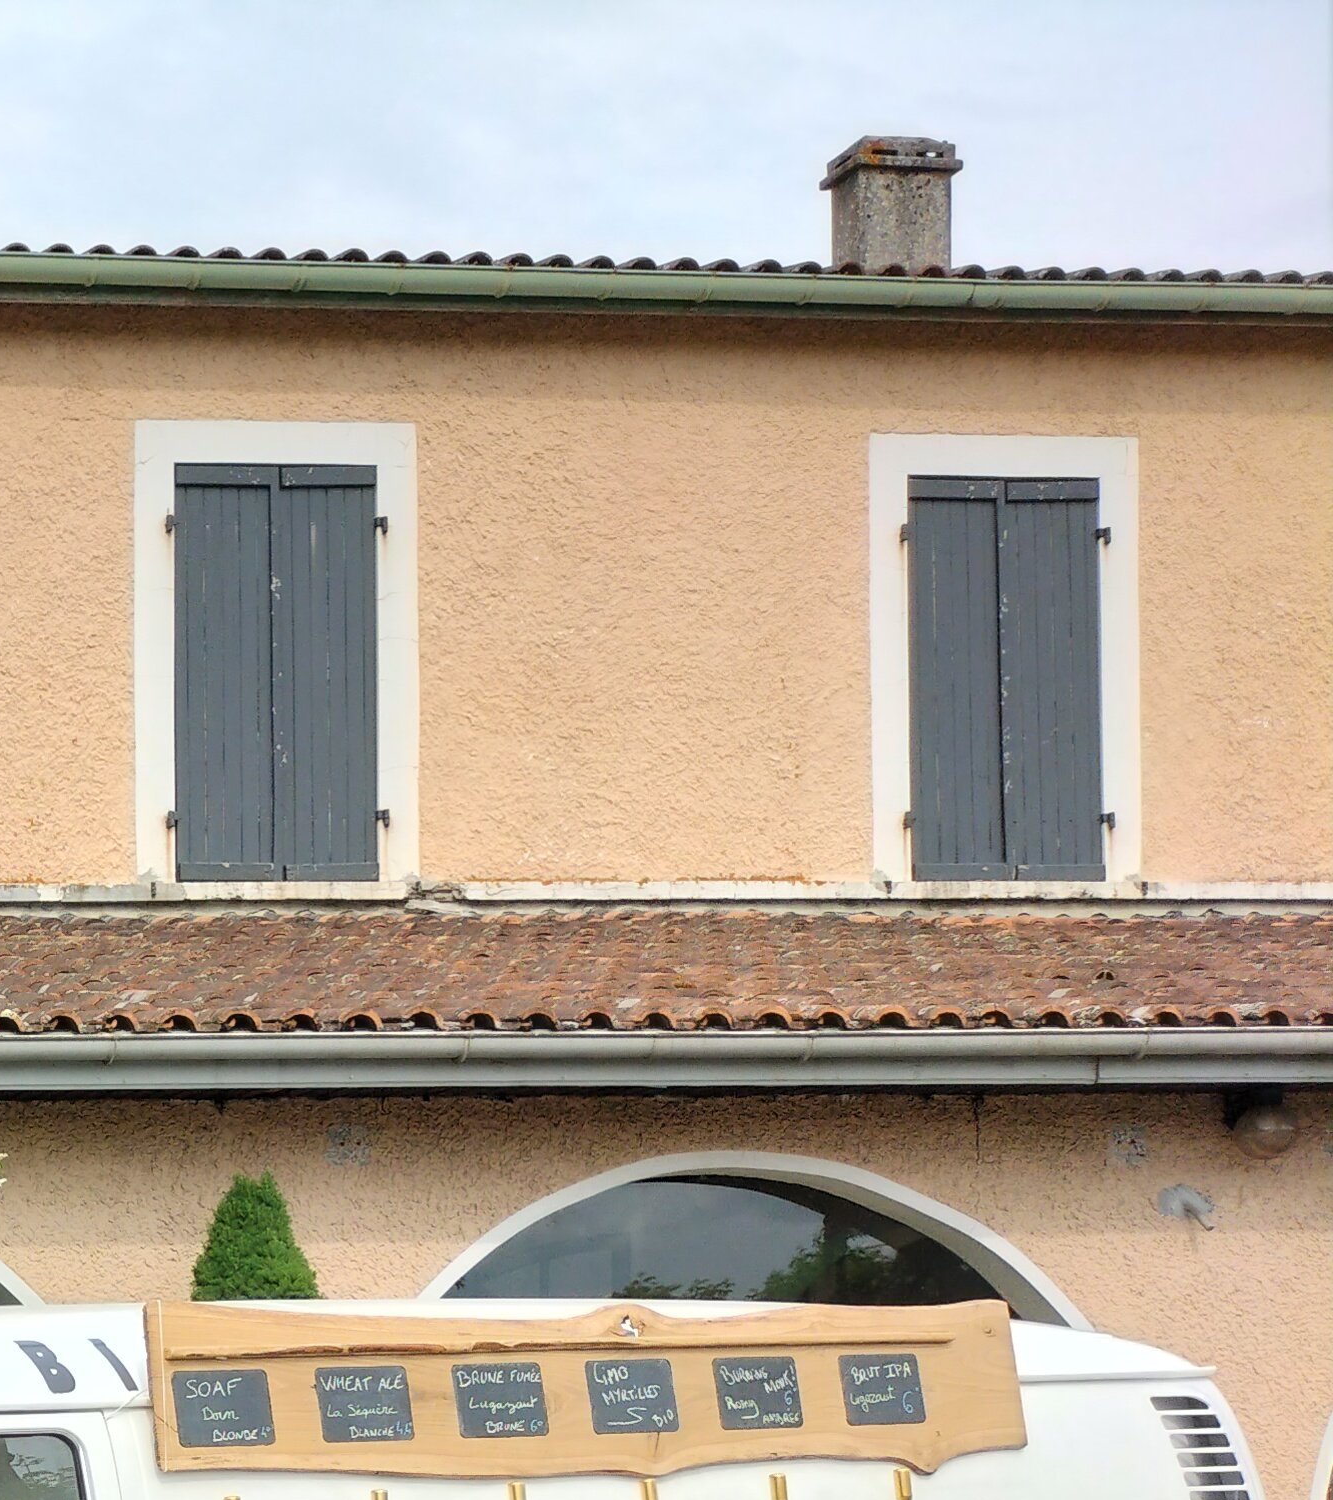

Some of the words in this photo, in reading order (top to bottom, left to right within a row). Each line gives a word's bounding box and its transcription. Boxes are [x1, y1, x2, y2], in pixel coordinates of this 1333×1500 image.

[457, 1370, 504, 1387] BRUNE
[851, 1366, 880, 1385] BRUT
[883, 1362, 912, 1378] IPA
[185, 1377, 242, 1398] SOAF
[320, 1375, 372, 1391] WHEAT
[378, 1374, 404, 1392] ALE
[326, 1404, 342, 1418] La
[213, 1428, 258, 1442] BLONDE
[485, 1420, 525, 1433] BRUNE
